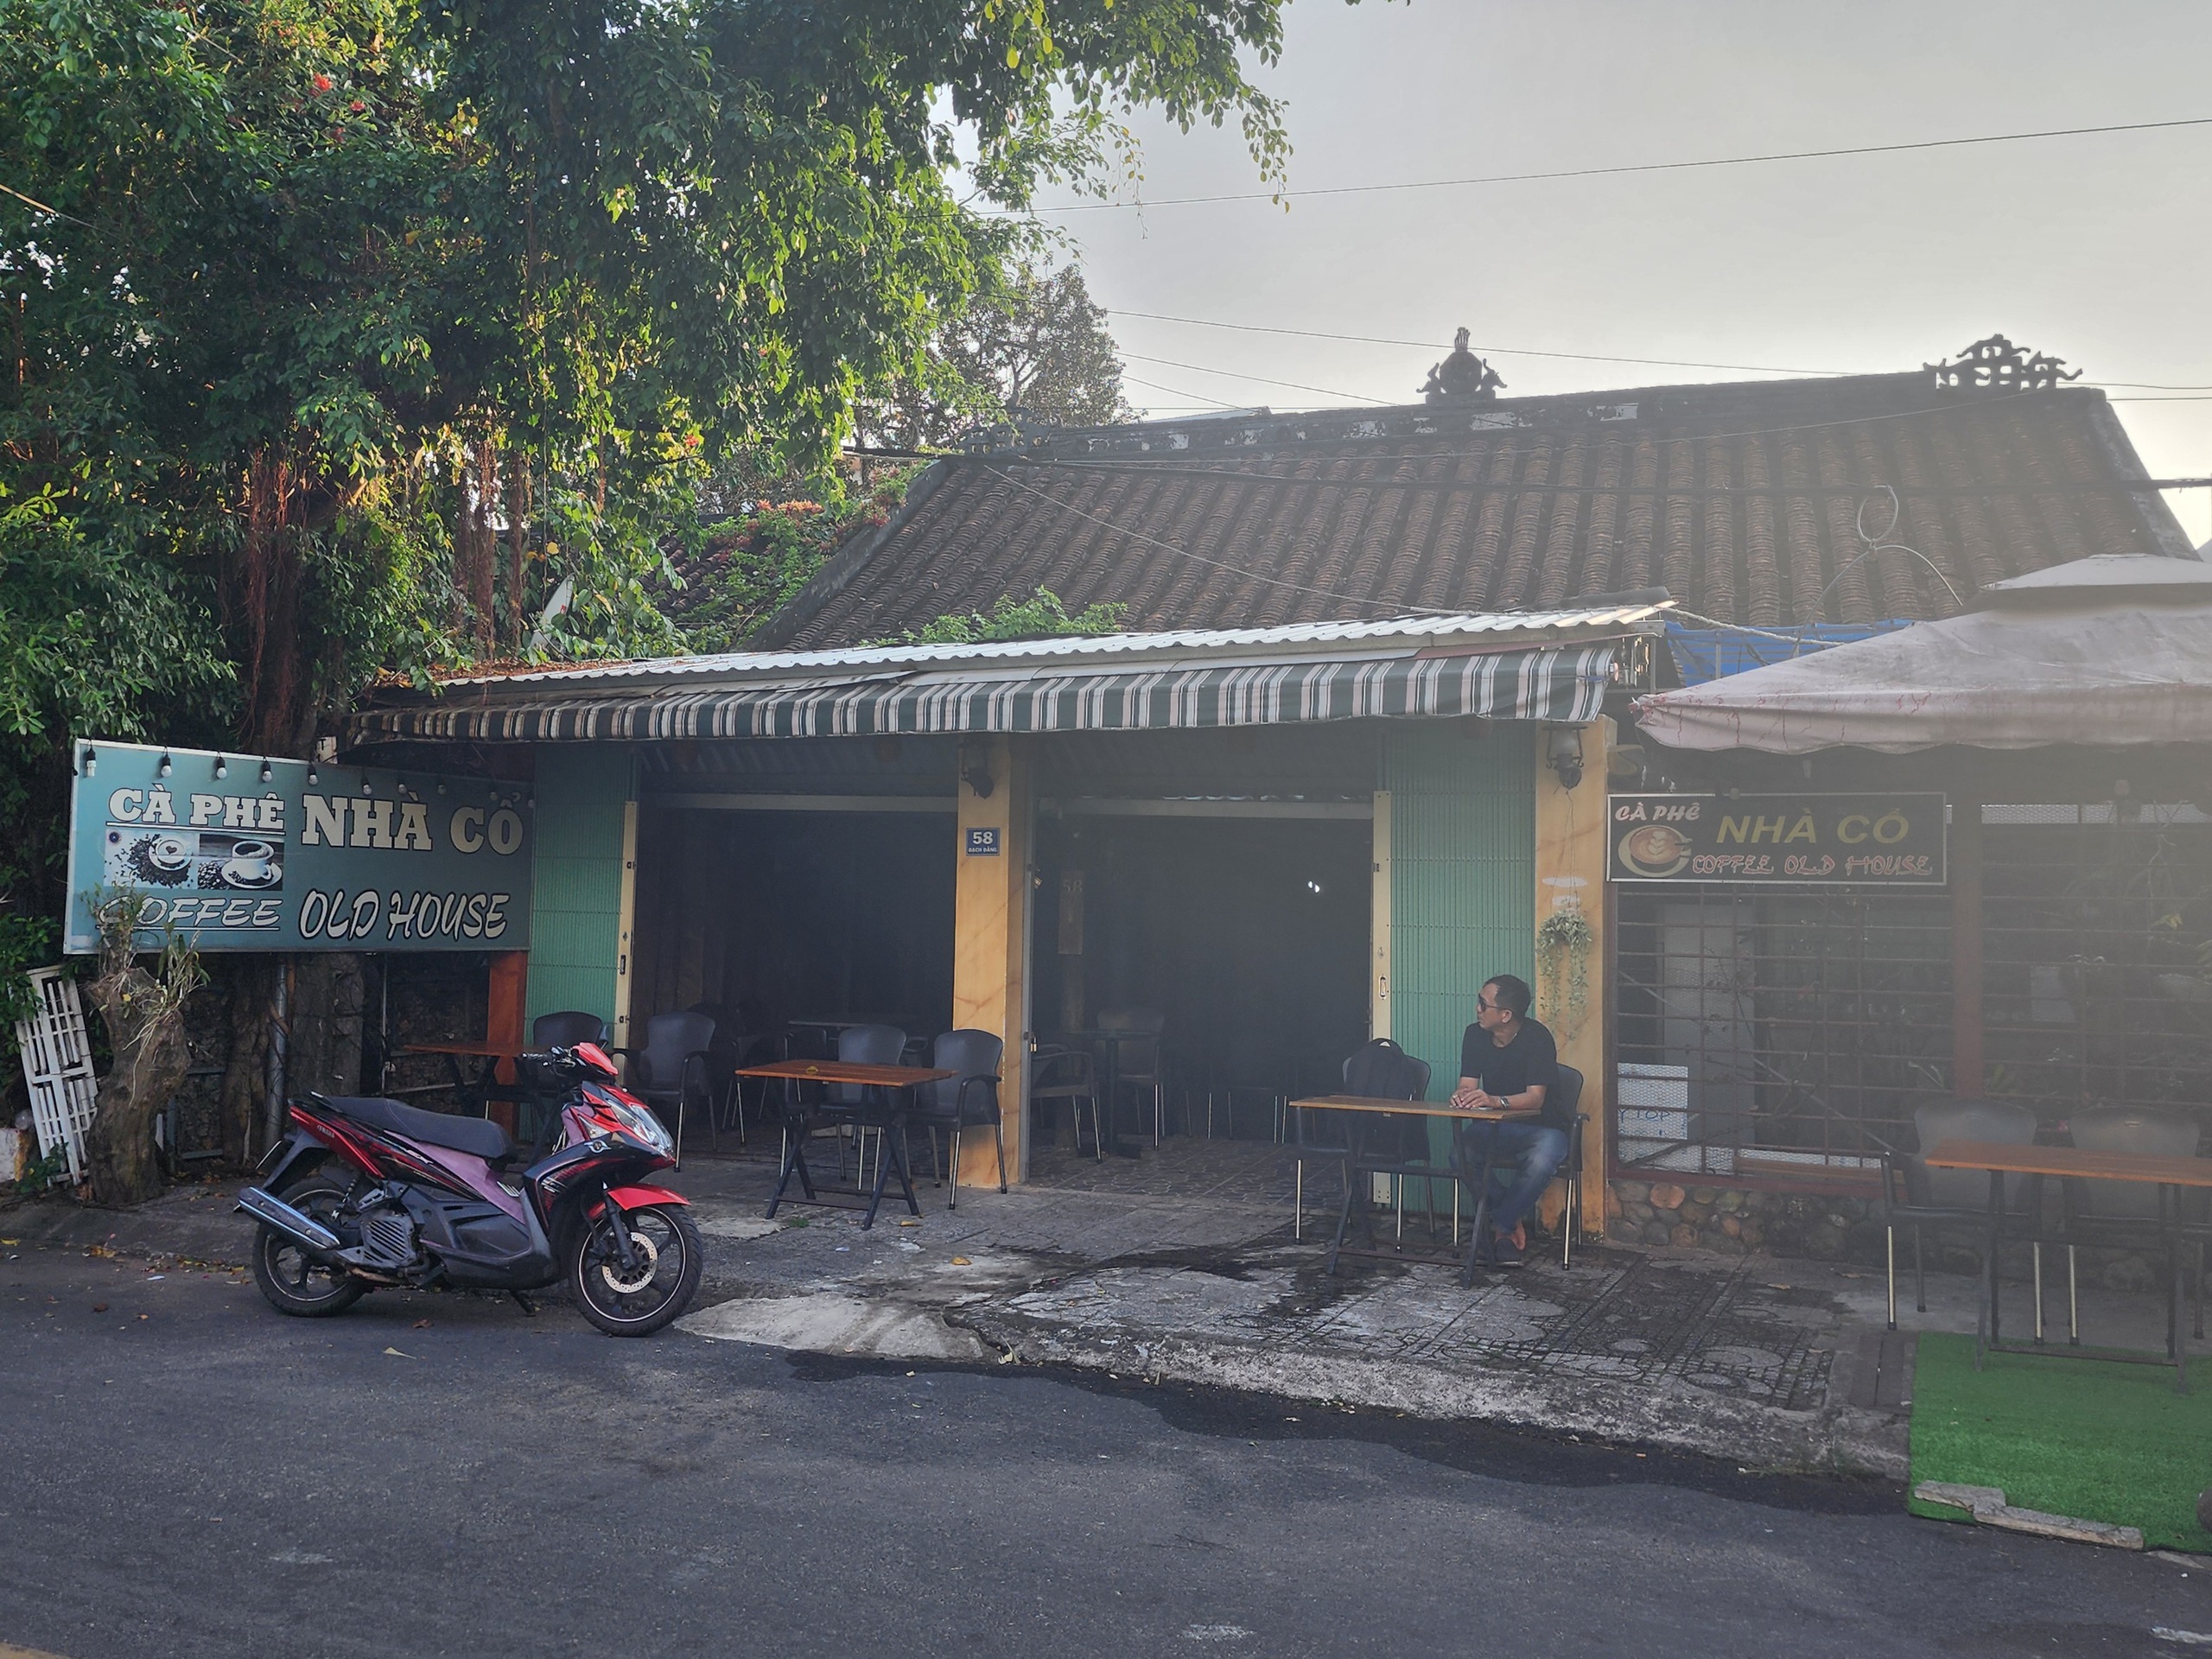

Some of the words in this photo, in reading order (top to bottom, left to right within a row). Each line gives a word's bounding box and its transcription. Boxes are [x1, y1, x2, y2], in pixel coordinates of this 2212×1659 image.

[108, 783, 176, 823] CÀ
[189, 791, 286, 830] PHÊ
[301, 790, 433, 850] NHÀ
[449, 791, 524, 855] CỔ
[1615, 802, 1647, 821] CÀ
[1652, 802, 1700, 821] PHÊ
[972, 831, 994, 845] 58
[1715, 807, 1817, 844] NHÀ
[1692, 855, 1774, 875] COFFEE
[1784, 855, 1836, 875] OLD
[1846, 855, 1933, 876] HOUSE
[298, 888, 380, 941] OLD
[387, 890, 511, 941] HOUSE
